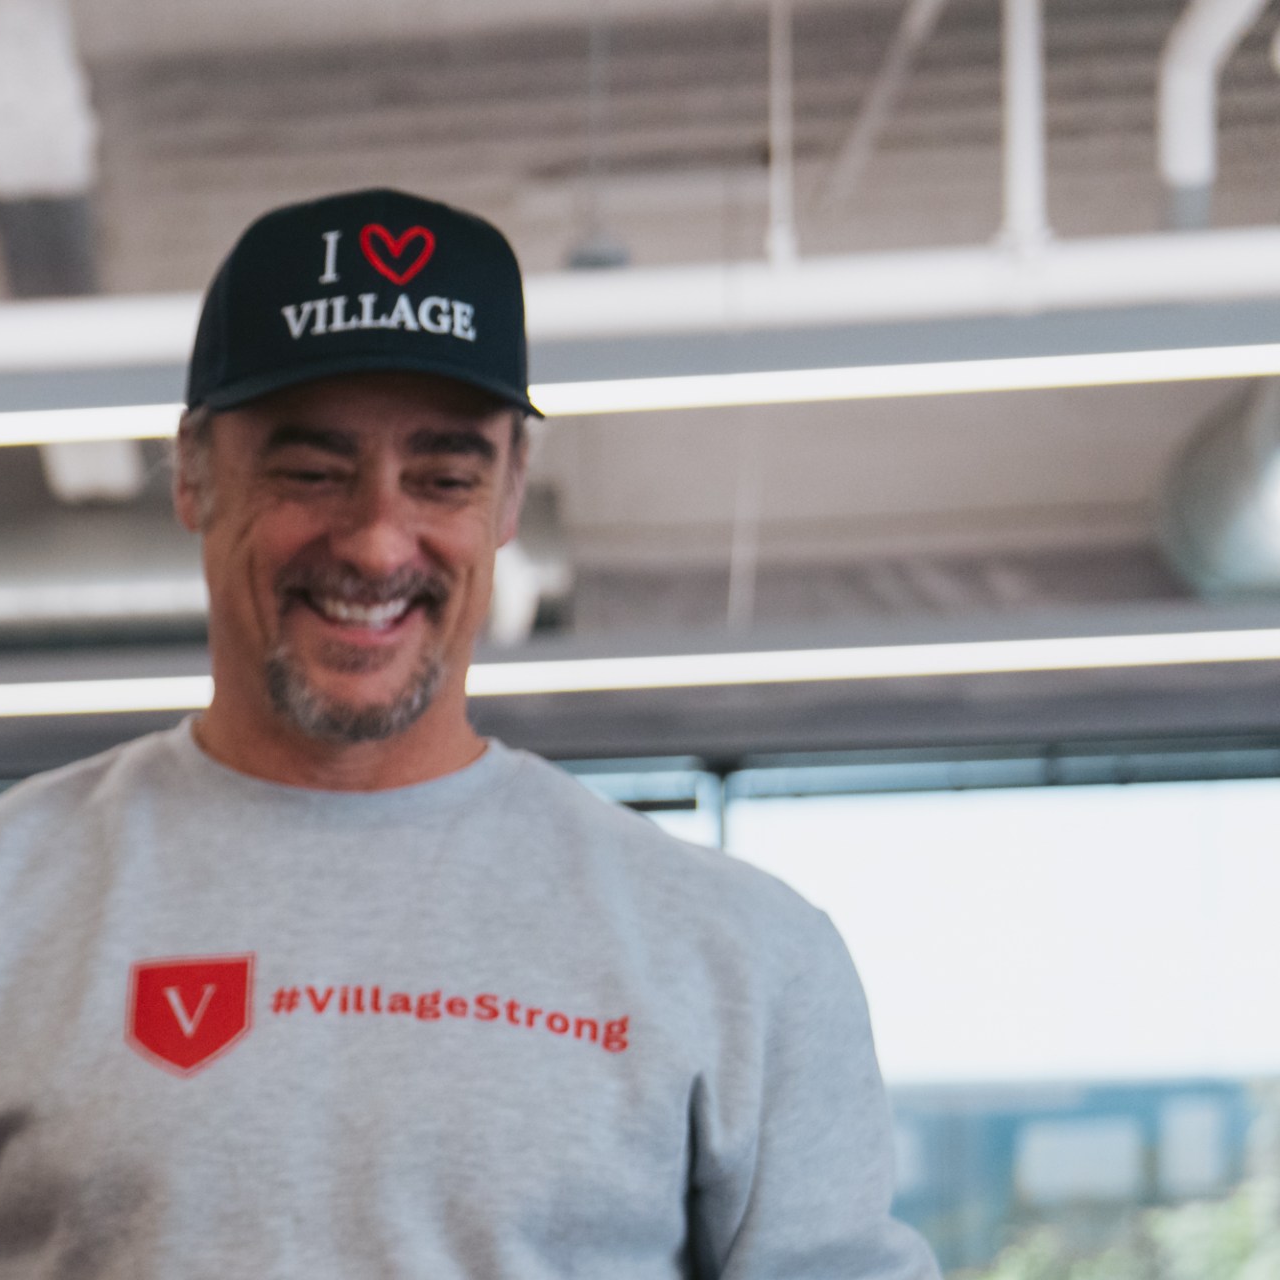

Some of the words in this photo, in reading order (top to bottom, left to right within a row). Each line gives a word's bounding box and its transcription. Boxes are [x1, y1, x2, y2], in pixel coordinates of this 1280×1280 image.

[319, 230, 342, 285] I
[281, 293, 478, 343] VILLAGE
[163, 983, 218, 1039] V
[269, 984, 631, 1054] #VillageStrong
